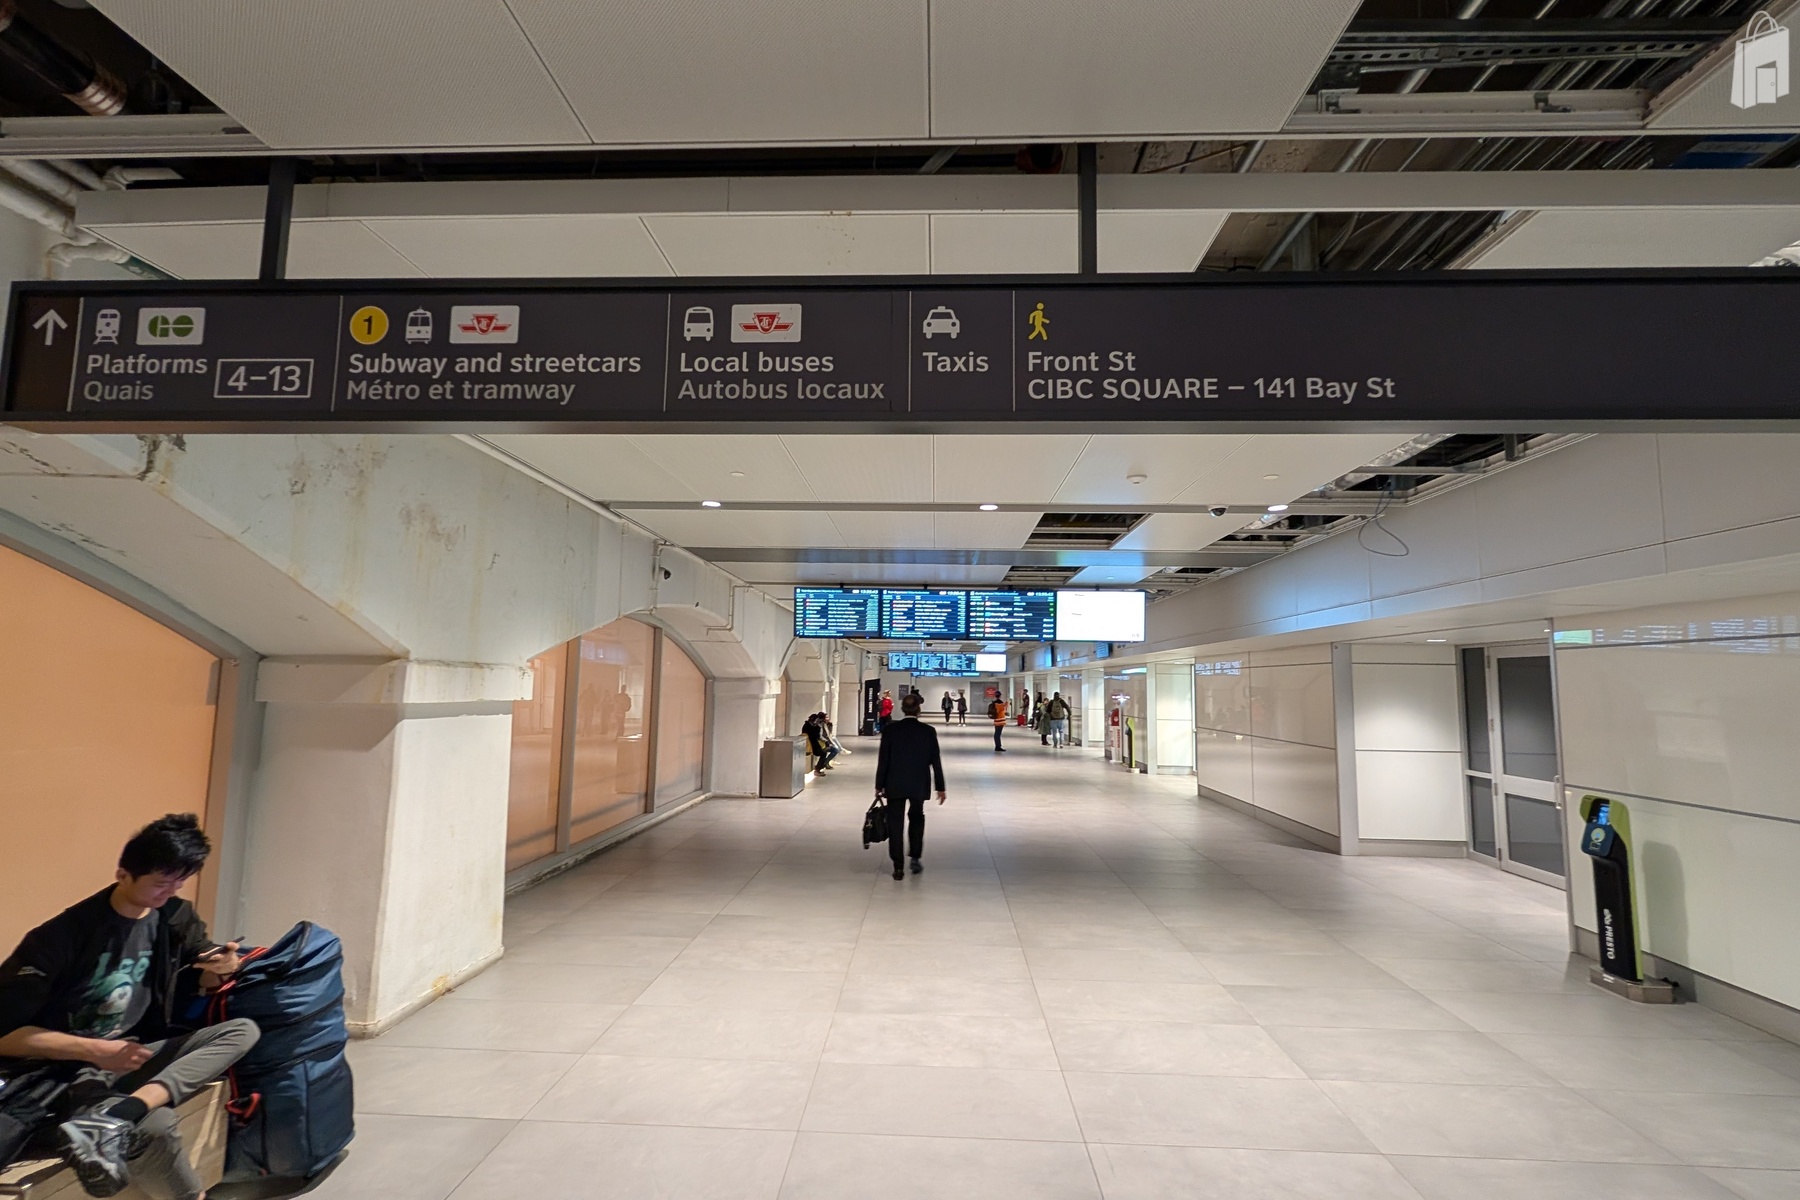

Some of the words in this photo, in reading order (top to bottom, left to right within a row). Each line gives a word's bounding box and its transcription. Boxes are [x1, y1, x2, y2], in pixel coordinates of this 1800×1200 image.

[86, 353, 208, 374] Platforms
[348, 352, 448, 378] Subway
[454, 351, 502, 373] and
[510, 353, 641, 373] streetcars
[680, 351, 749, 373] Local
[758, 351, 834, 373] buses
[922, 351, 989, 373] Taxis
[1028, 351, 1100, 372] Front
[1108, 350, 1136, 372] St
[83, 380, 154, 403] Quais
[346, 378, 421, 400] Métro
[428, 377, 455, 400] et
[461, 380, 576, 406] tramway
[677, 378, 788, 400] Autobus
[797, 378, 885, 400] locaux
[1027, 378, 1094, 400] CIBC
[1102, 377, 1219, 402] SQUARE
[1253, 377, 1296, 399] 141
[1305, 377, 1358, 405] Bay
[1366, 376, 1396, 399] St
[1605, 925, 1616, 960] PRESTO
